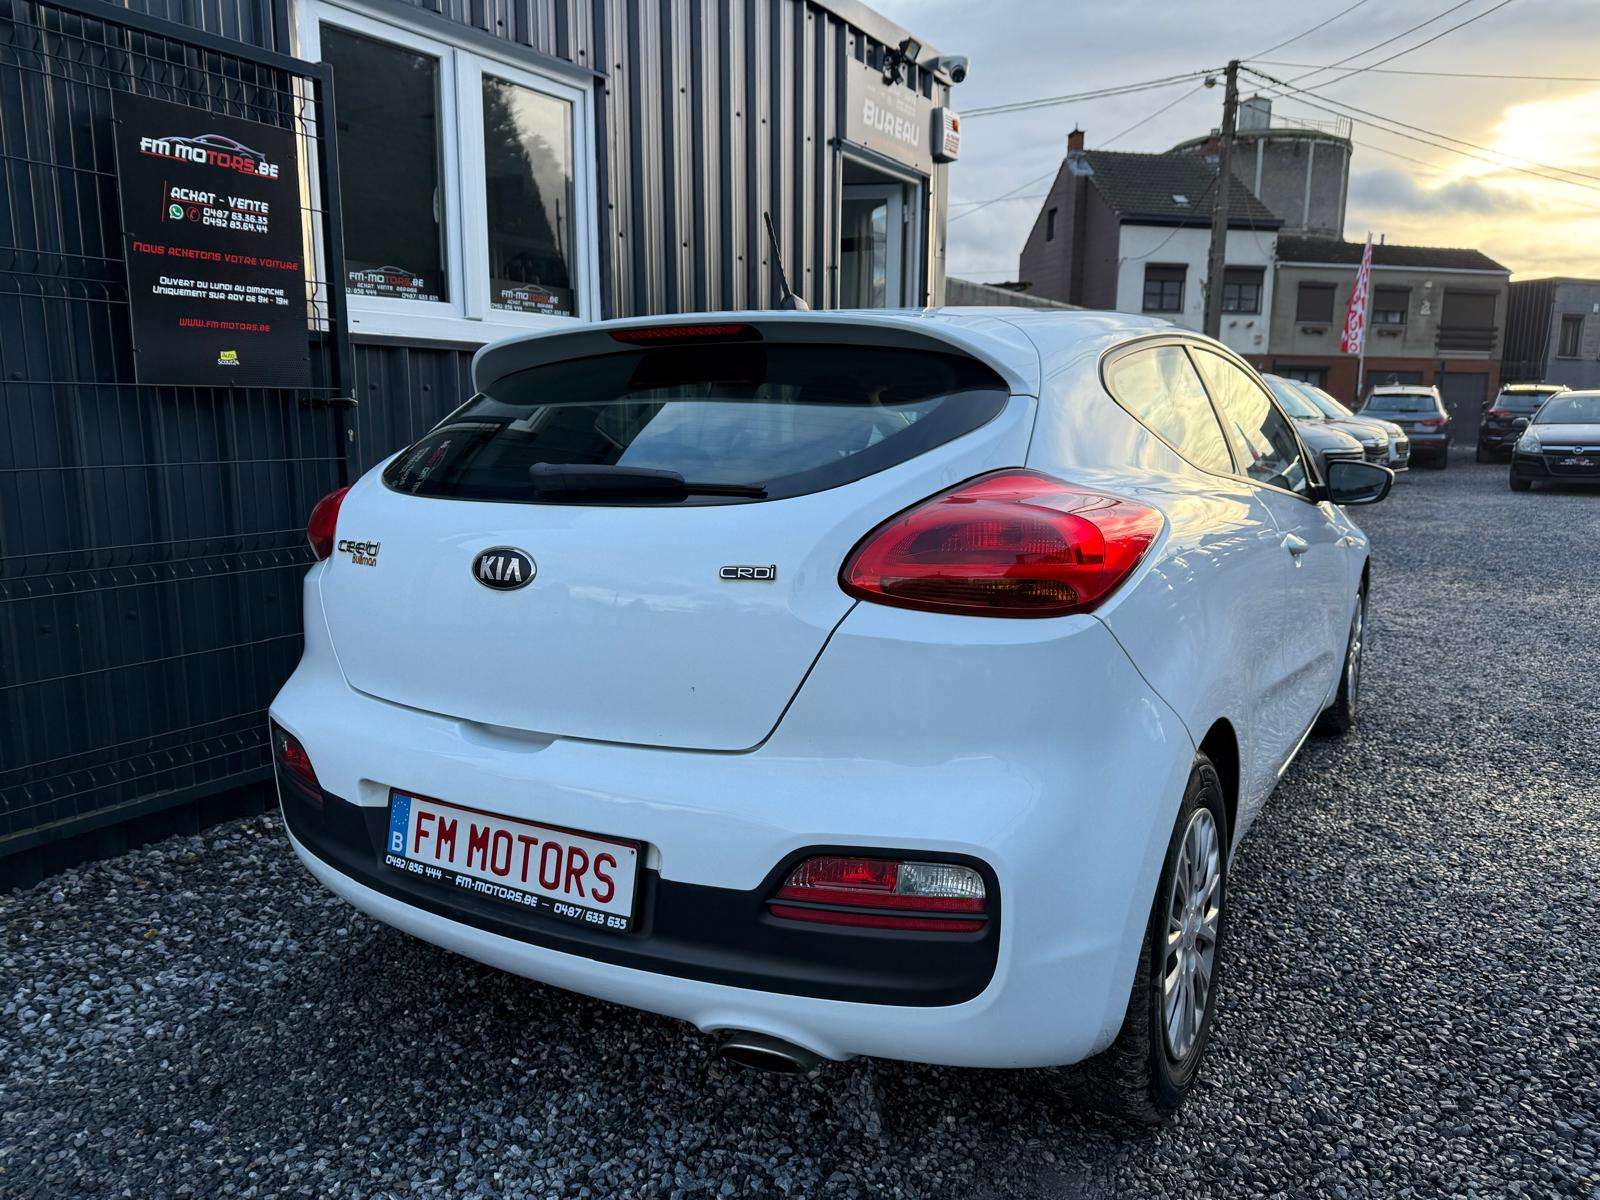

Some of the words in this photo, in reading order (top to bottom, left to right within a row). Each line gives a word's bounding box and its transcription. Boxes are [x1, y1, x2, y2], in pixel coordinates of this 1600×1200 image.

[863, 98, 920, 146] BUREAU
[140, 137, 170, 155] FM
[175, 144, 279, 177] MOTORS.BE
[170, 187, 216, 204] ACHAT
[228, 196, 269, 213] VENTE
[203, 207, 229, 218] 0487
[231, 212, 268, 224] 63.36.35
[203, 217, 228, 228] 0492
[230, 222, 268, 234] 85.64.44
[133, 241, 165, 255] NOUS
[168, 247, 222, 262] ACHETONS
[224, 254, 257, 266] VOTRE
[259, 258, 299, 270] VOITURE
[152, 285, 207, 298] UNIQUEMENT
[209, 291, 226, 300] SUR
[228, 292, 244, 302] RDV
[246, 294, 257, 303] DE
[159, 276, 195, 287] OUVERT
[197, 280, 209, 288] DU
[210, 281, 233, 291] LUNDI
[234, 284, 245, 293] AU
[246, 285, 284, 296] DIMANCHE
[480, 555, 522, 582] KIA
[719, 564, 776, 580] CRDi
[392, 831, 403, 851] B
[414, 810, 458, 862] FM
[466, 823, 617, 904] MOTORS
[425, 867, 443, 880] 444
[455, 874, 538, 907] FM-MOTORS.BE
